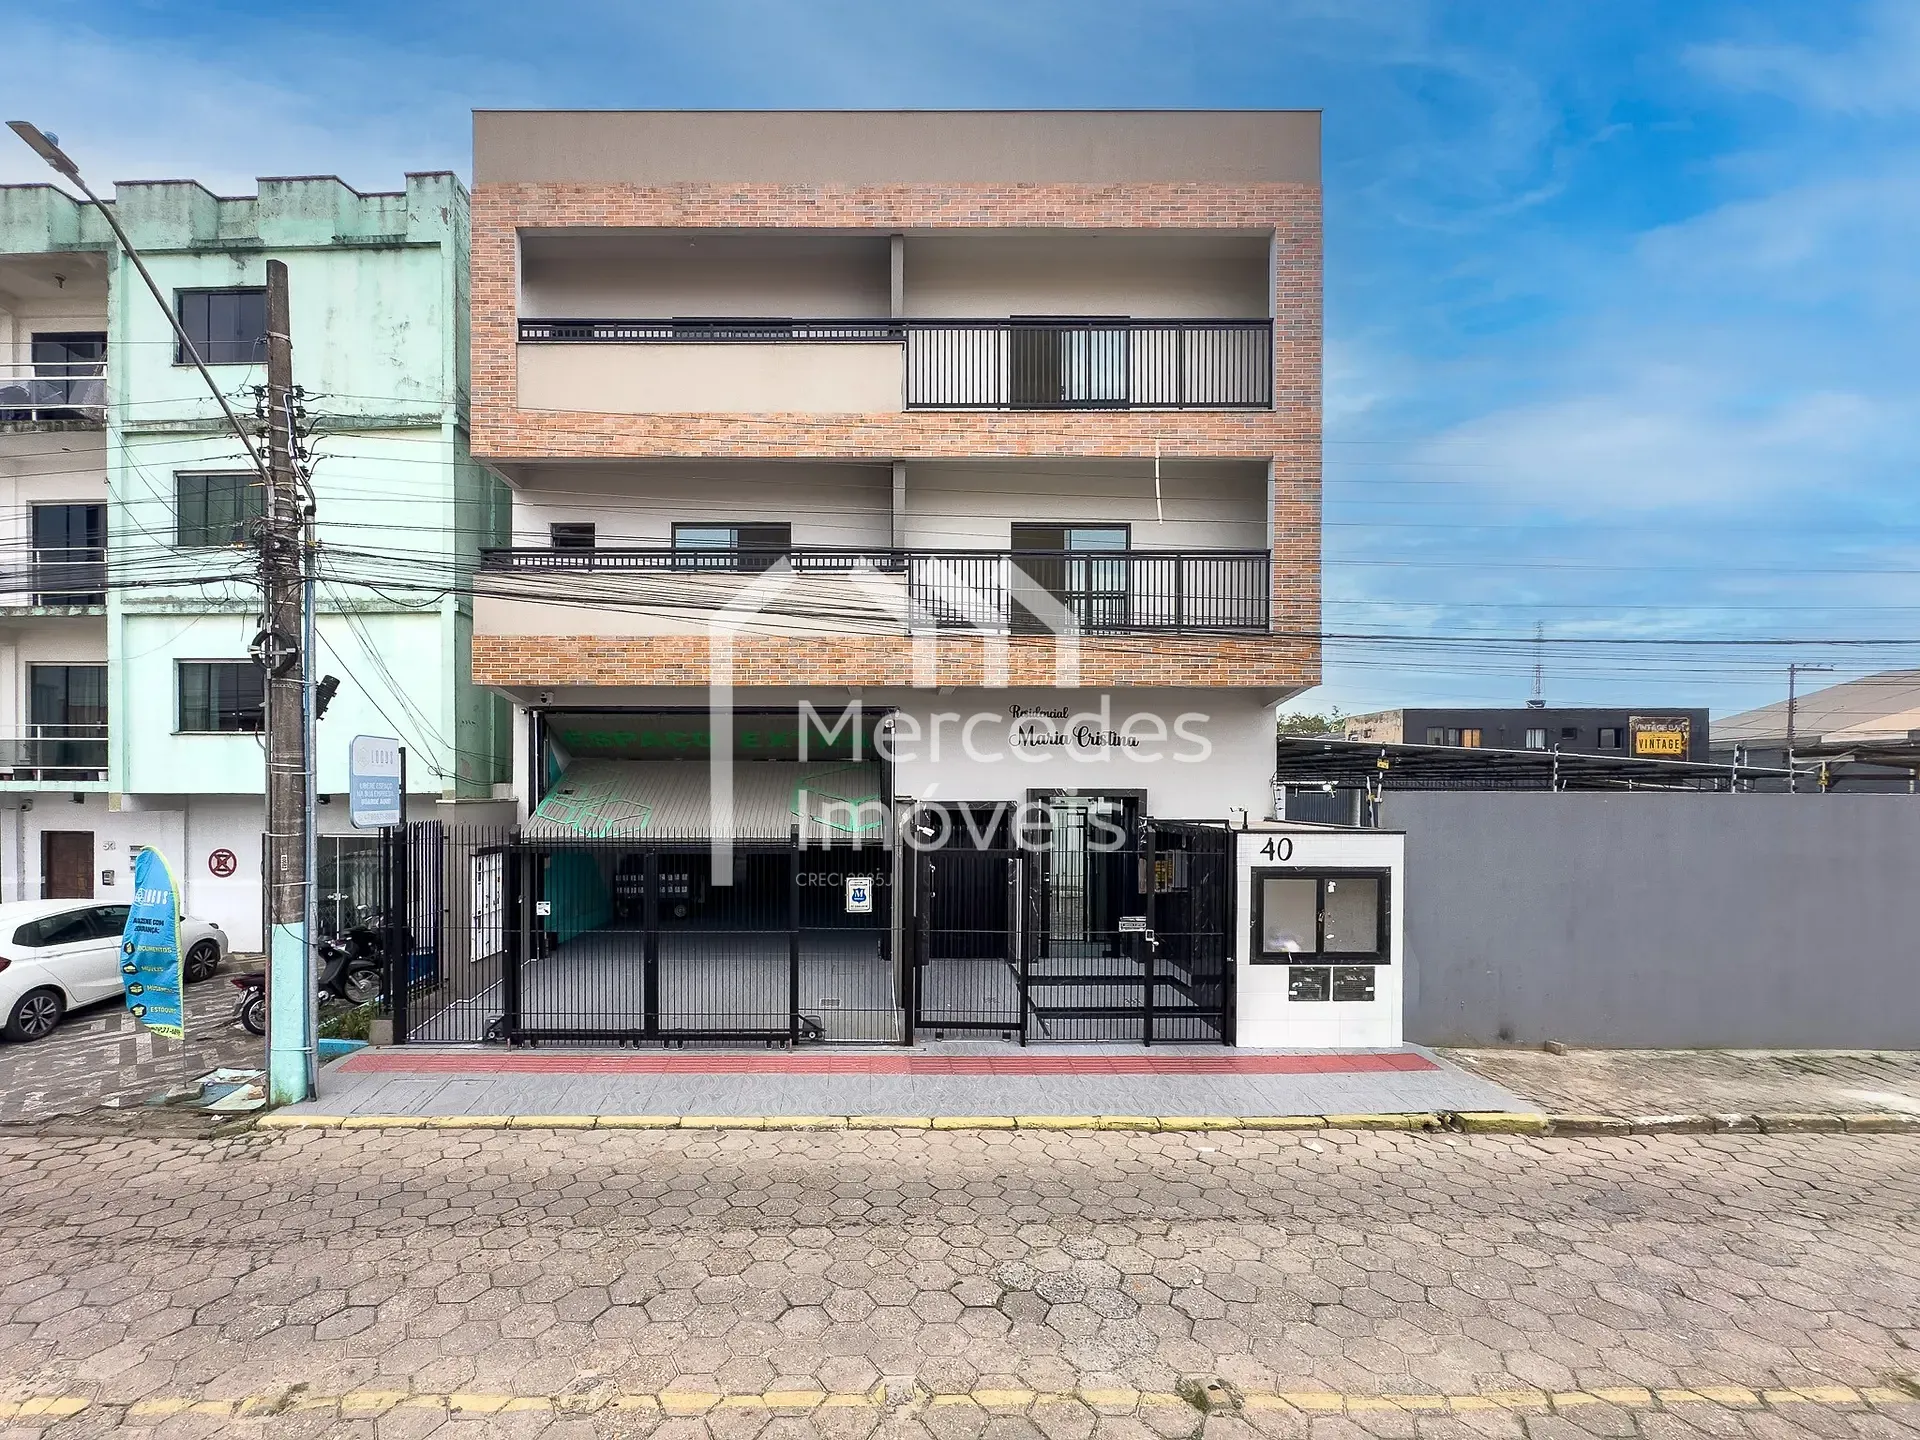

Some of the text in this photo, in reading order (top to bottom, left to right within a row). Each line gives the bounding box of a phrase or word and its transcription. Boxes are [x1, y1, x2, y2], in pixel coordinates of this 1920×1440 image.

[1009, 704, 1069, 719] Residencial
[1009, 725, 1140, 748] Maria Cristina
[1638, 738, 1680, 749] VINTAGE
[1260, 837, 1294, 861] 40
